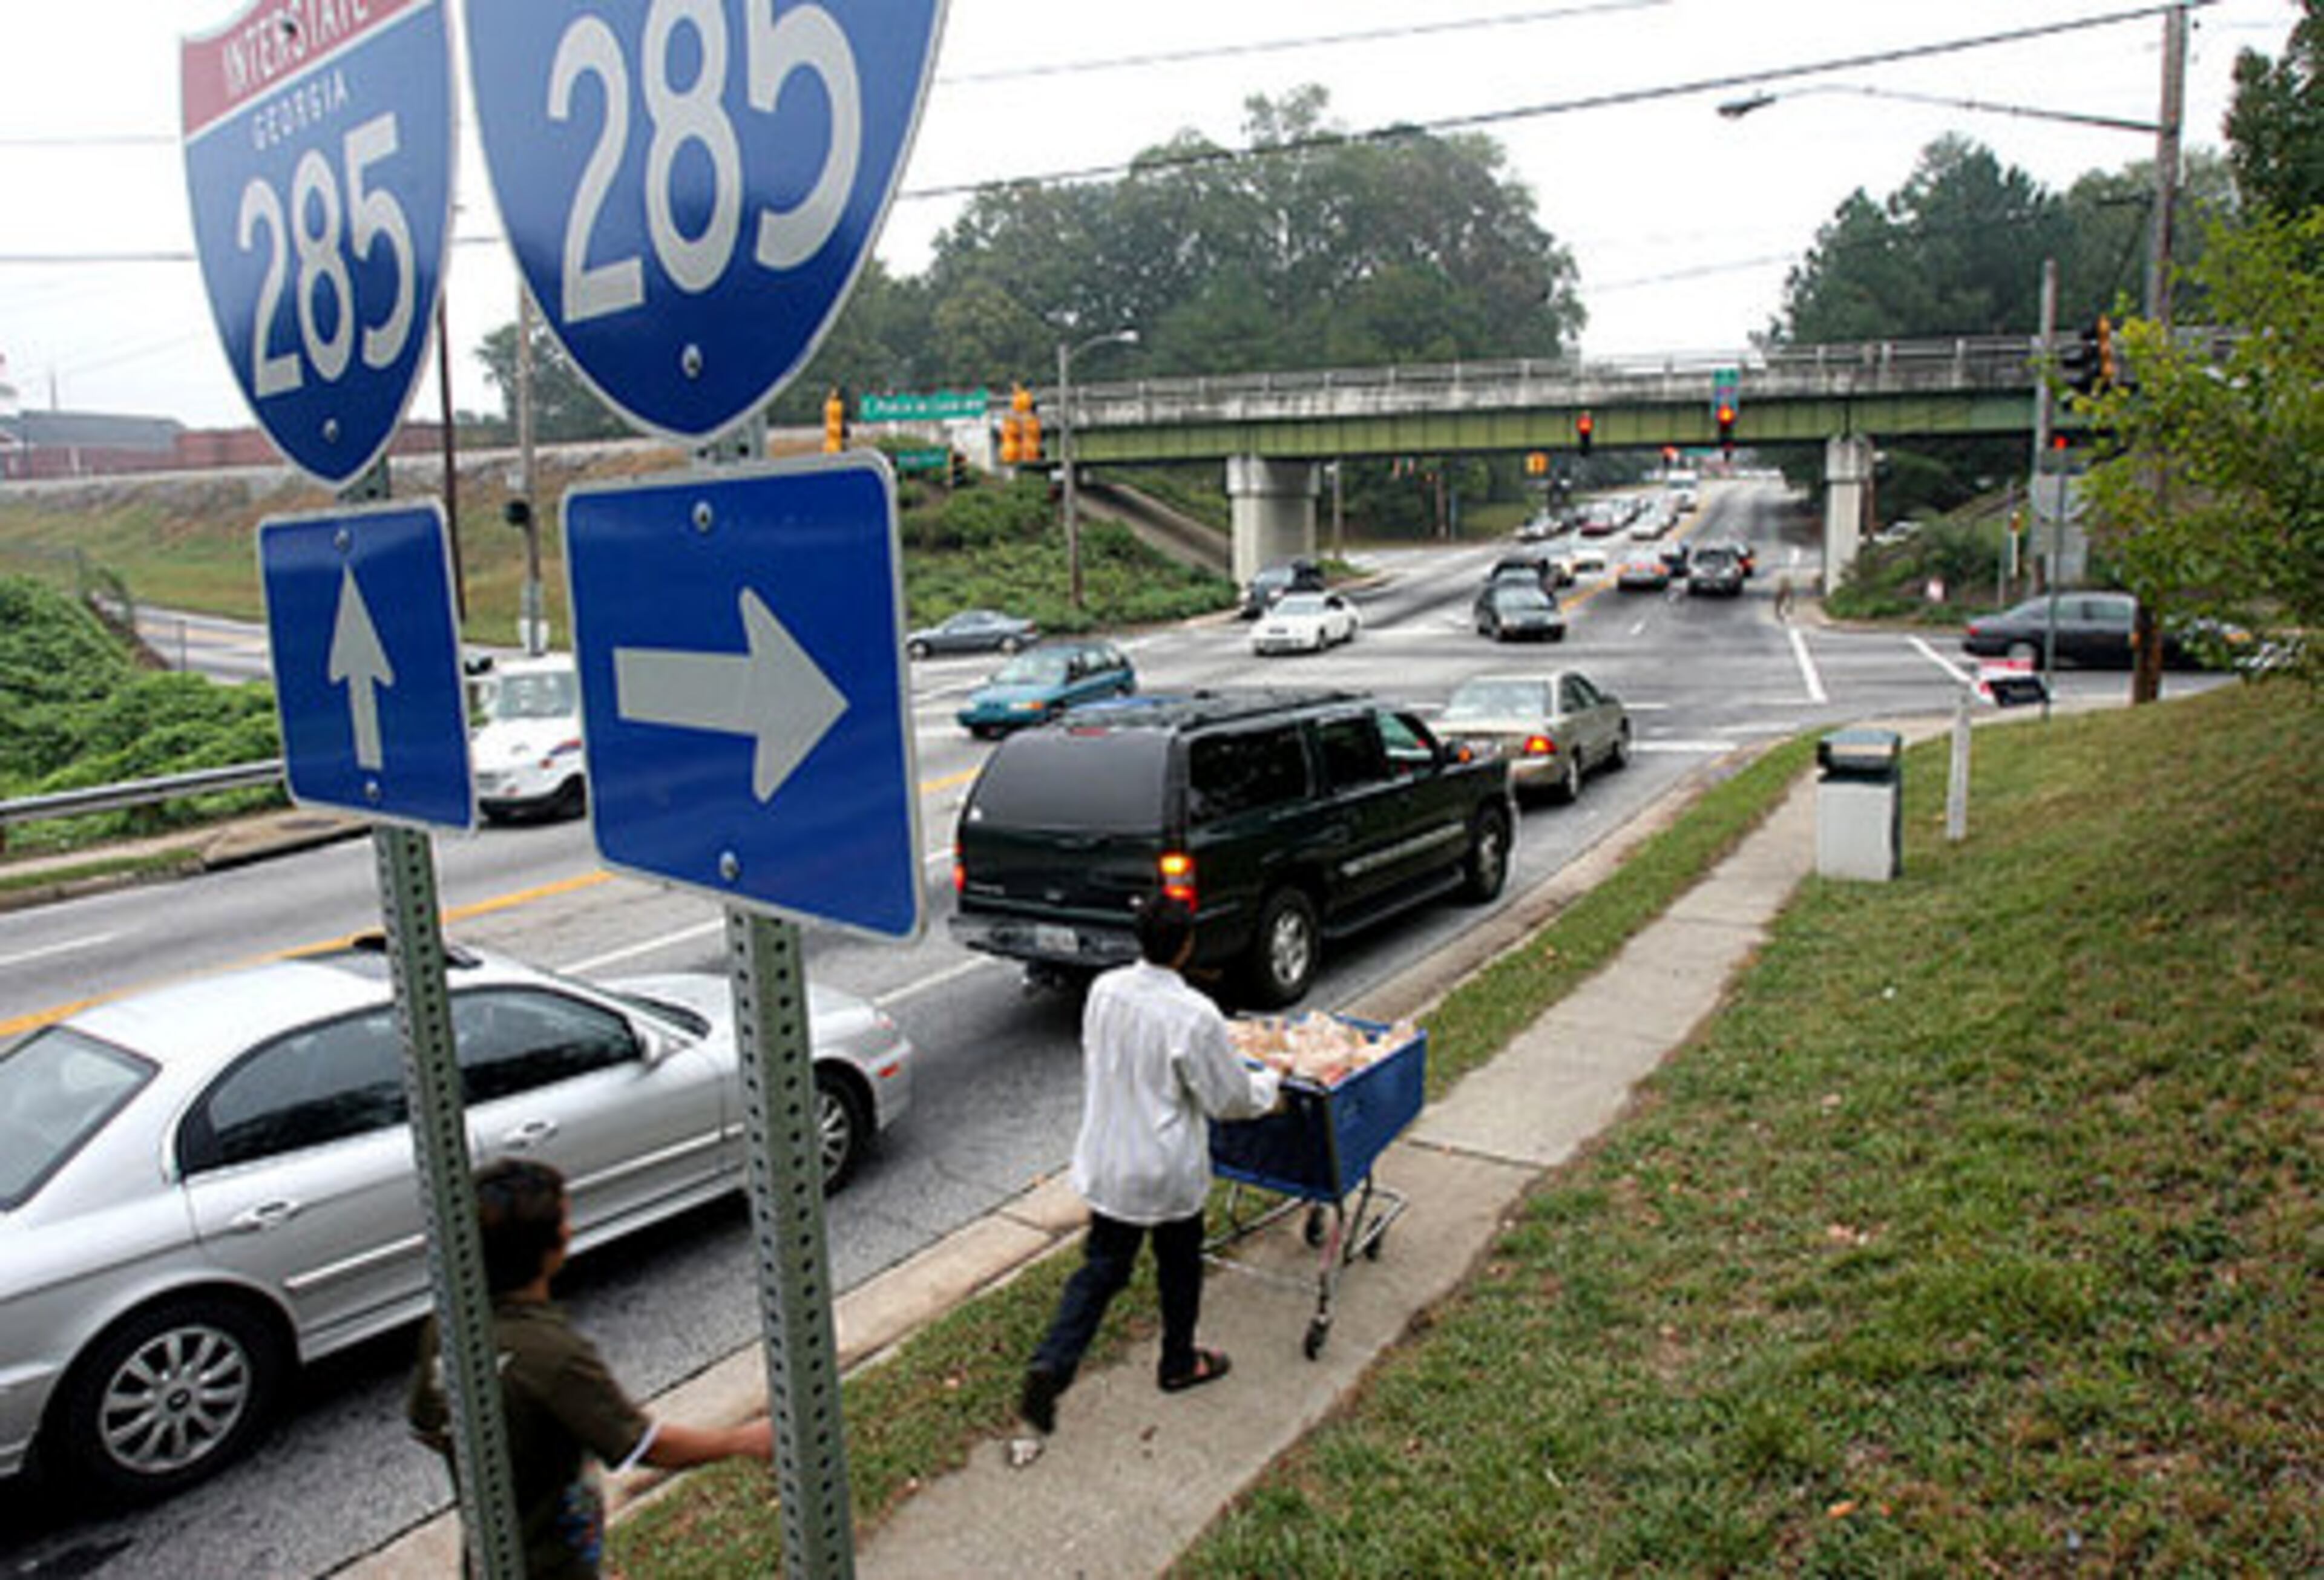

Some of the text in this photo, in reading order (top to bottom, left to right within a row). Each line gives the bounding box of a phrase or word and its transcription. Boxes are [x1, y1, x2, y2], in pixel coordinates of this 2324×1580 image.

[253, 68, 350, 150] GEORGIA
[547, 0, 861, 323] 285
[237, 111, 415, 398] 285
